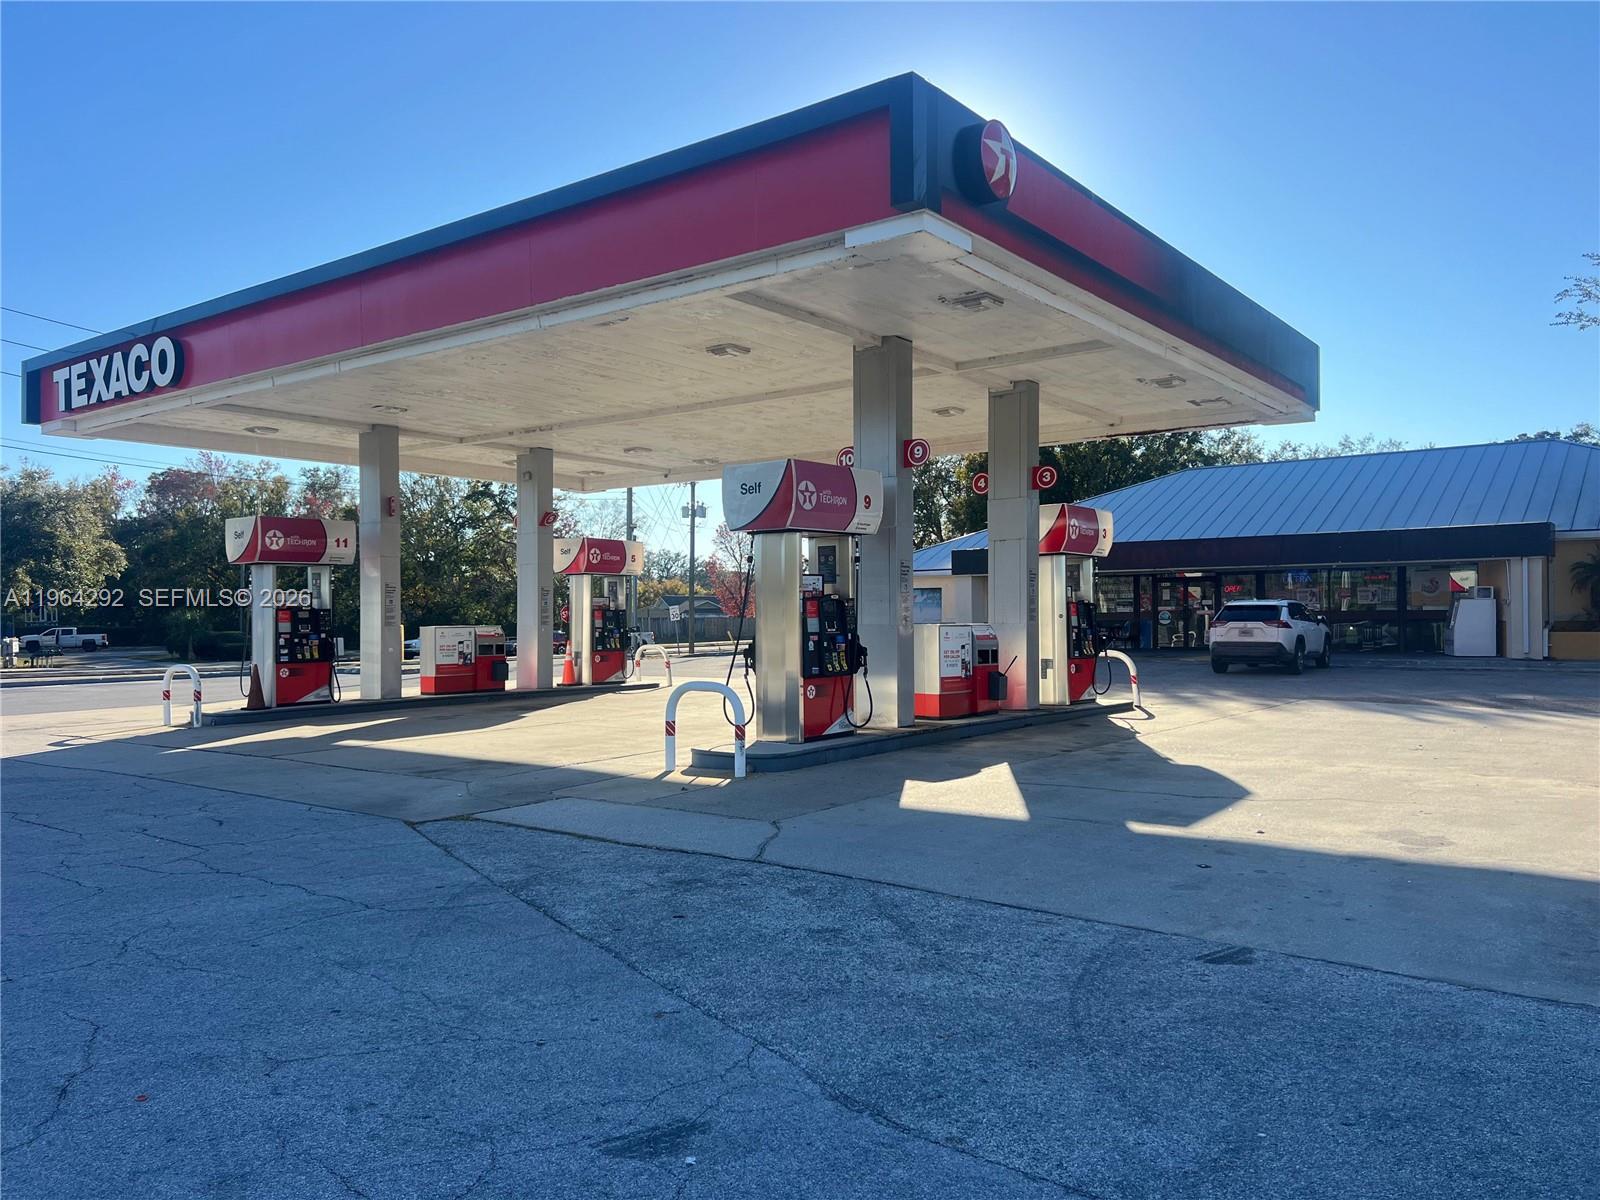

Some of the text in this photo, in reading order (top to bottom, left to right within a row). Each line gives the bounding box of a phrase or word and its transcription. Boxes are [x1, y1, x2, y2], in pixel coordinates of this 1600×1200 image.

[53, 336, 176, 412] TEXACO
[914, 445, 923, 459] 9
[840, 453, 854, 466] 10
[1042, 471, 1051, 482] 3
[740, 481, 762, 495] Self
[977, 477, 986, 488] 4
[819, 493, 848, 506] TECHRON
[863, 494, 872, 510] 9
[233, 530, 245, 540] Self
[1102, 528, 1107, 539] 3
[287, 538, 317, 547] TECHRON
[335, 538, 348, 548] 11
[560, 548, 571, 556] Self
[631, 555, 636, 563] 5
